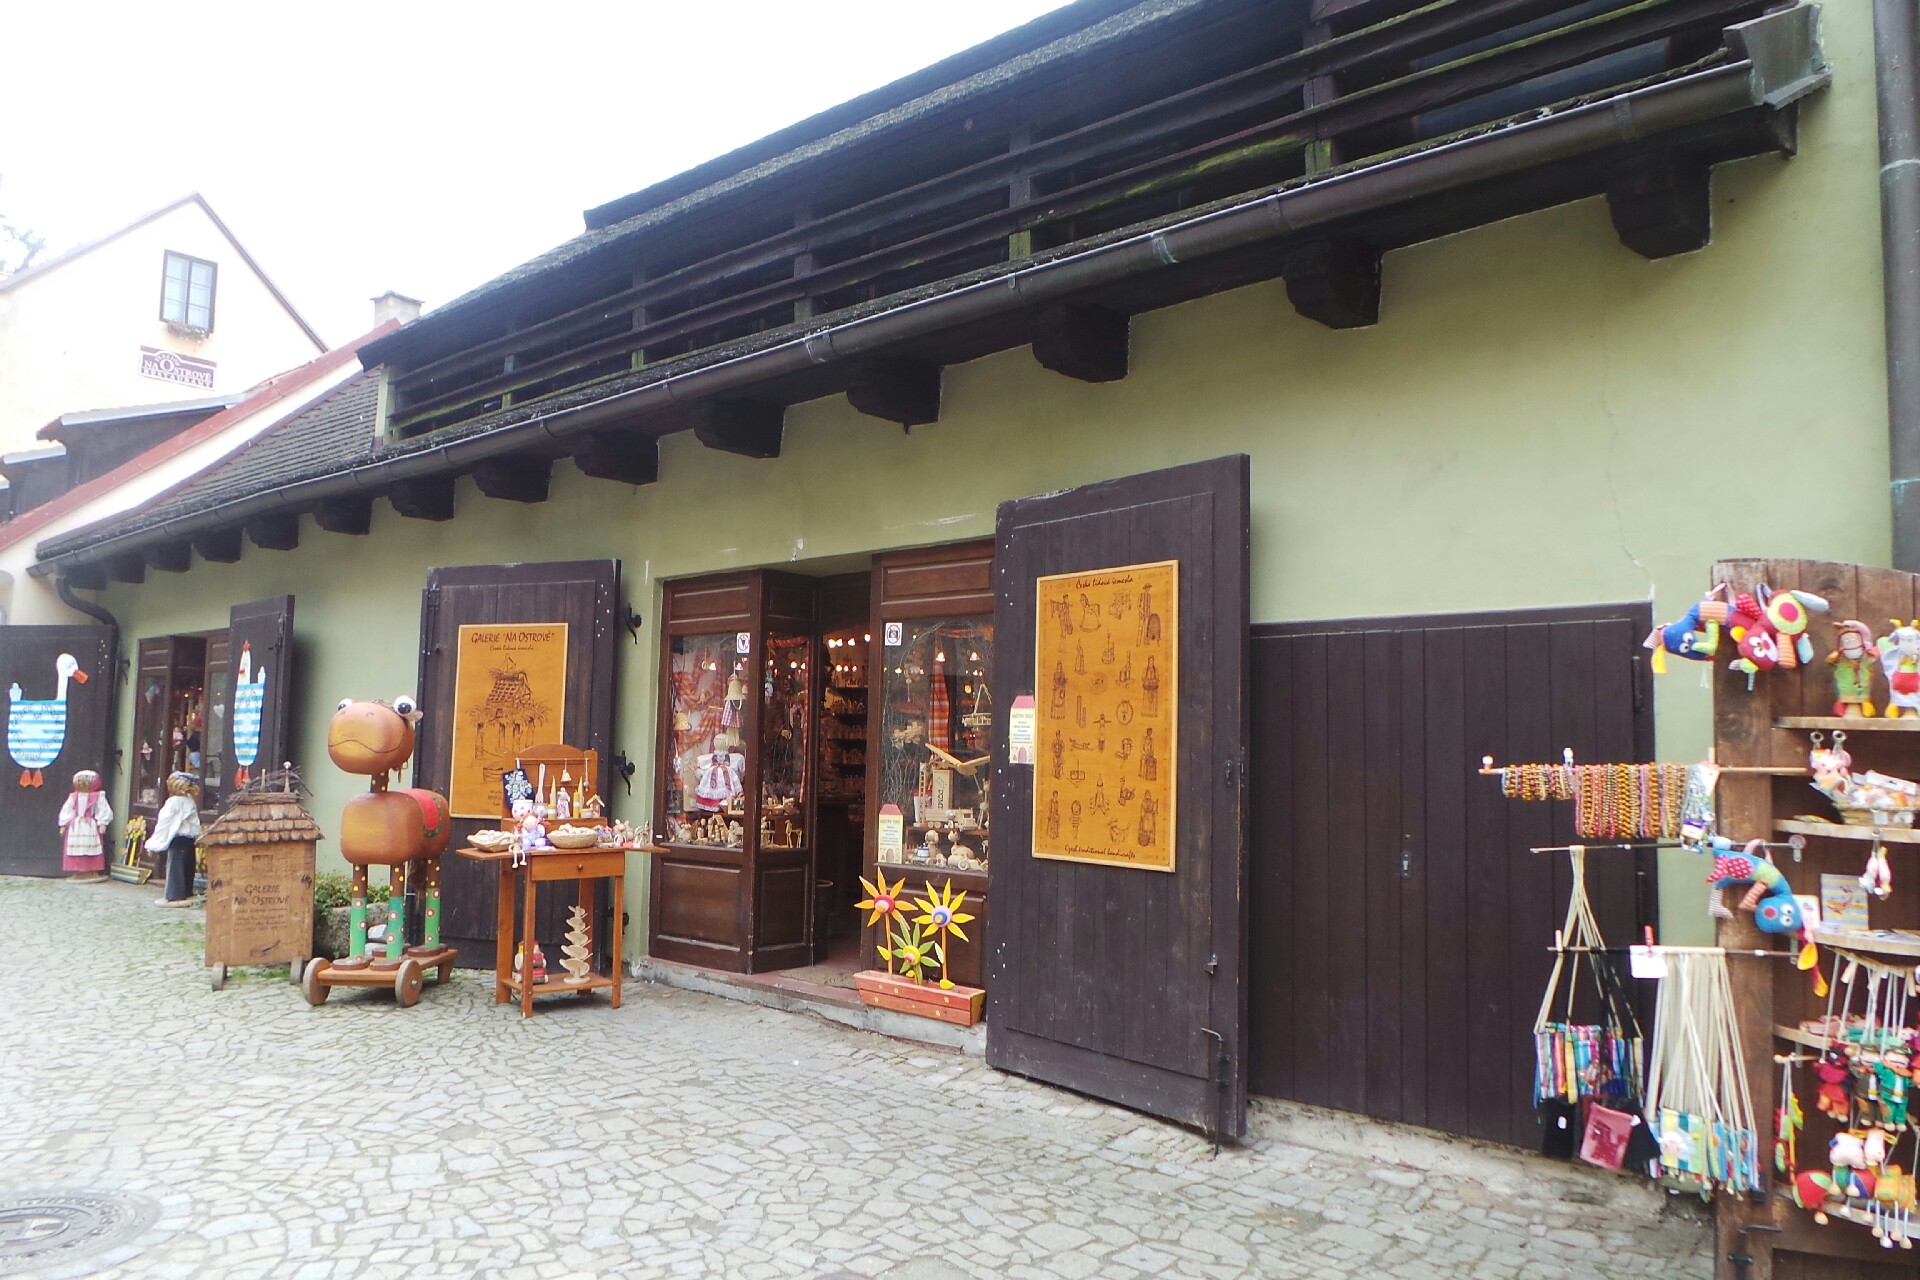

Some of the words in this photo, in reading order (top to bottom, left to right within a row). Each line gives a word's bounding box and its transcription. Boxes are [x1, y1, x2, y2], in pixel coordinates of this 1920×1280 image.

[143, 360, 159, 370] NA
[471, 632, 501, 644] GALERIE
[244, 884, 280, 896] GALERIE
